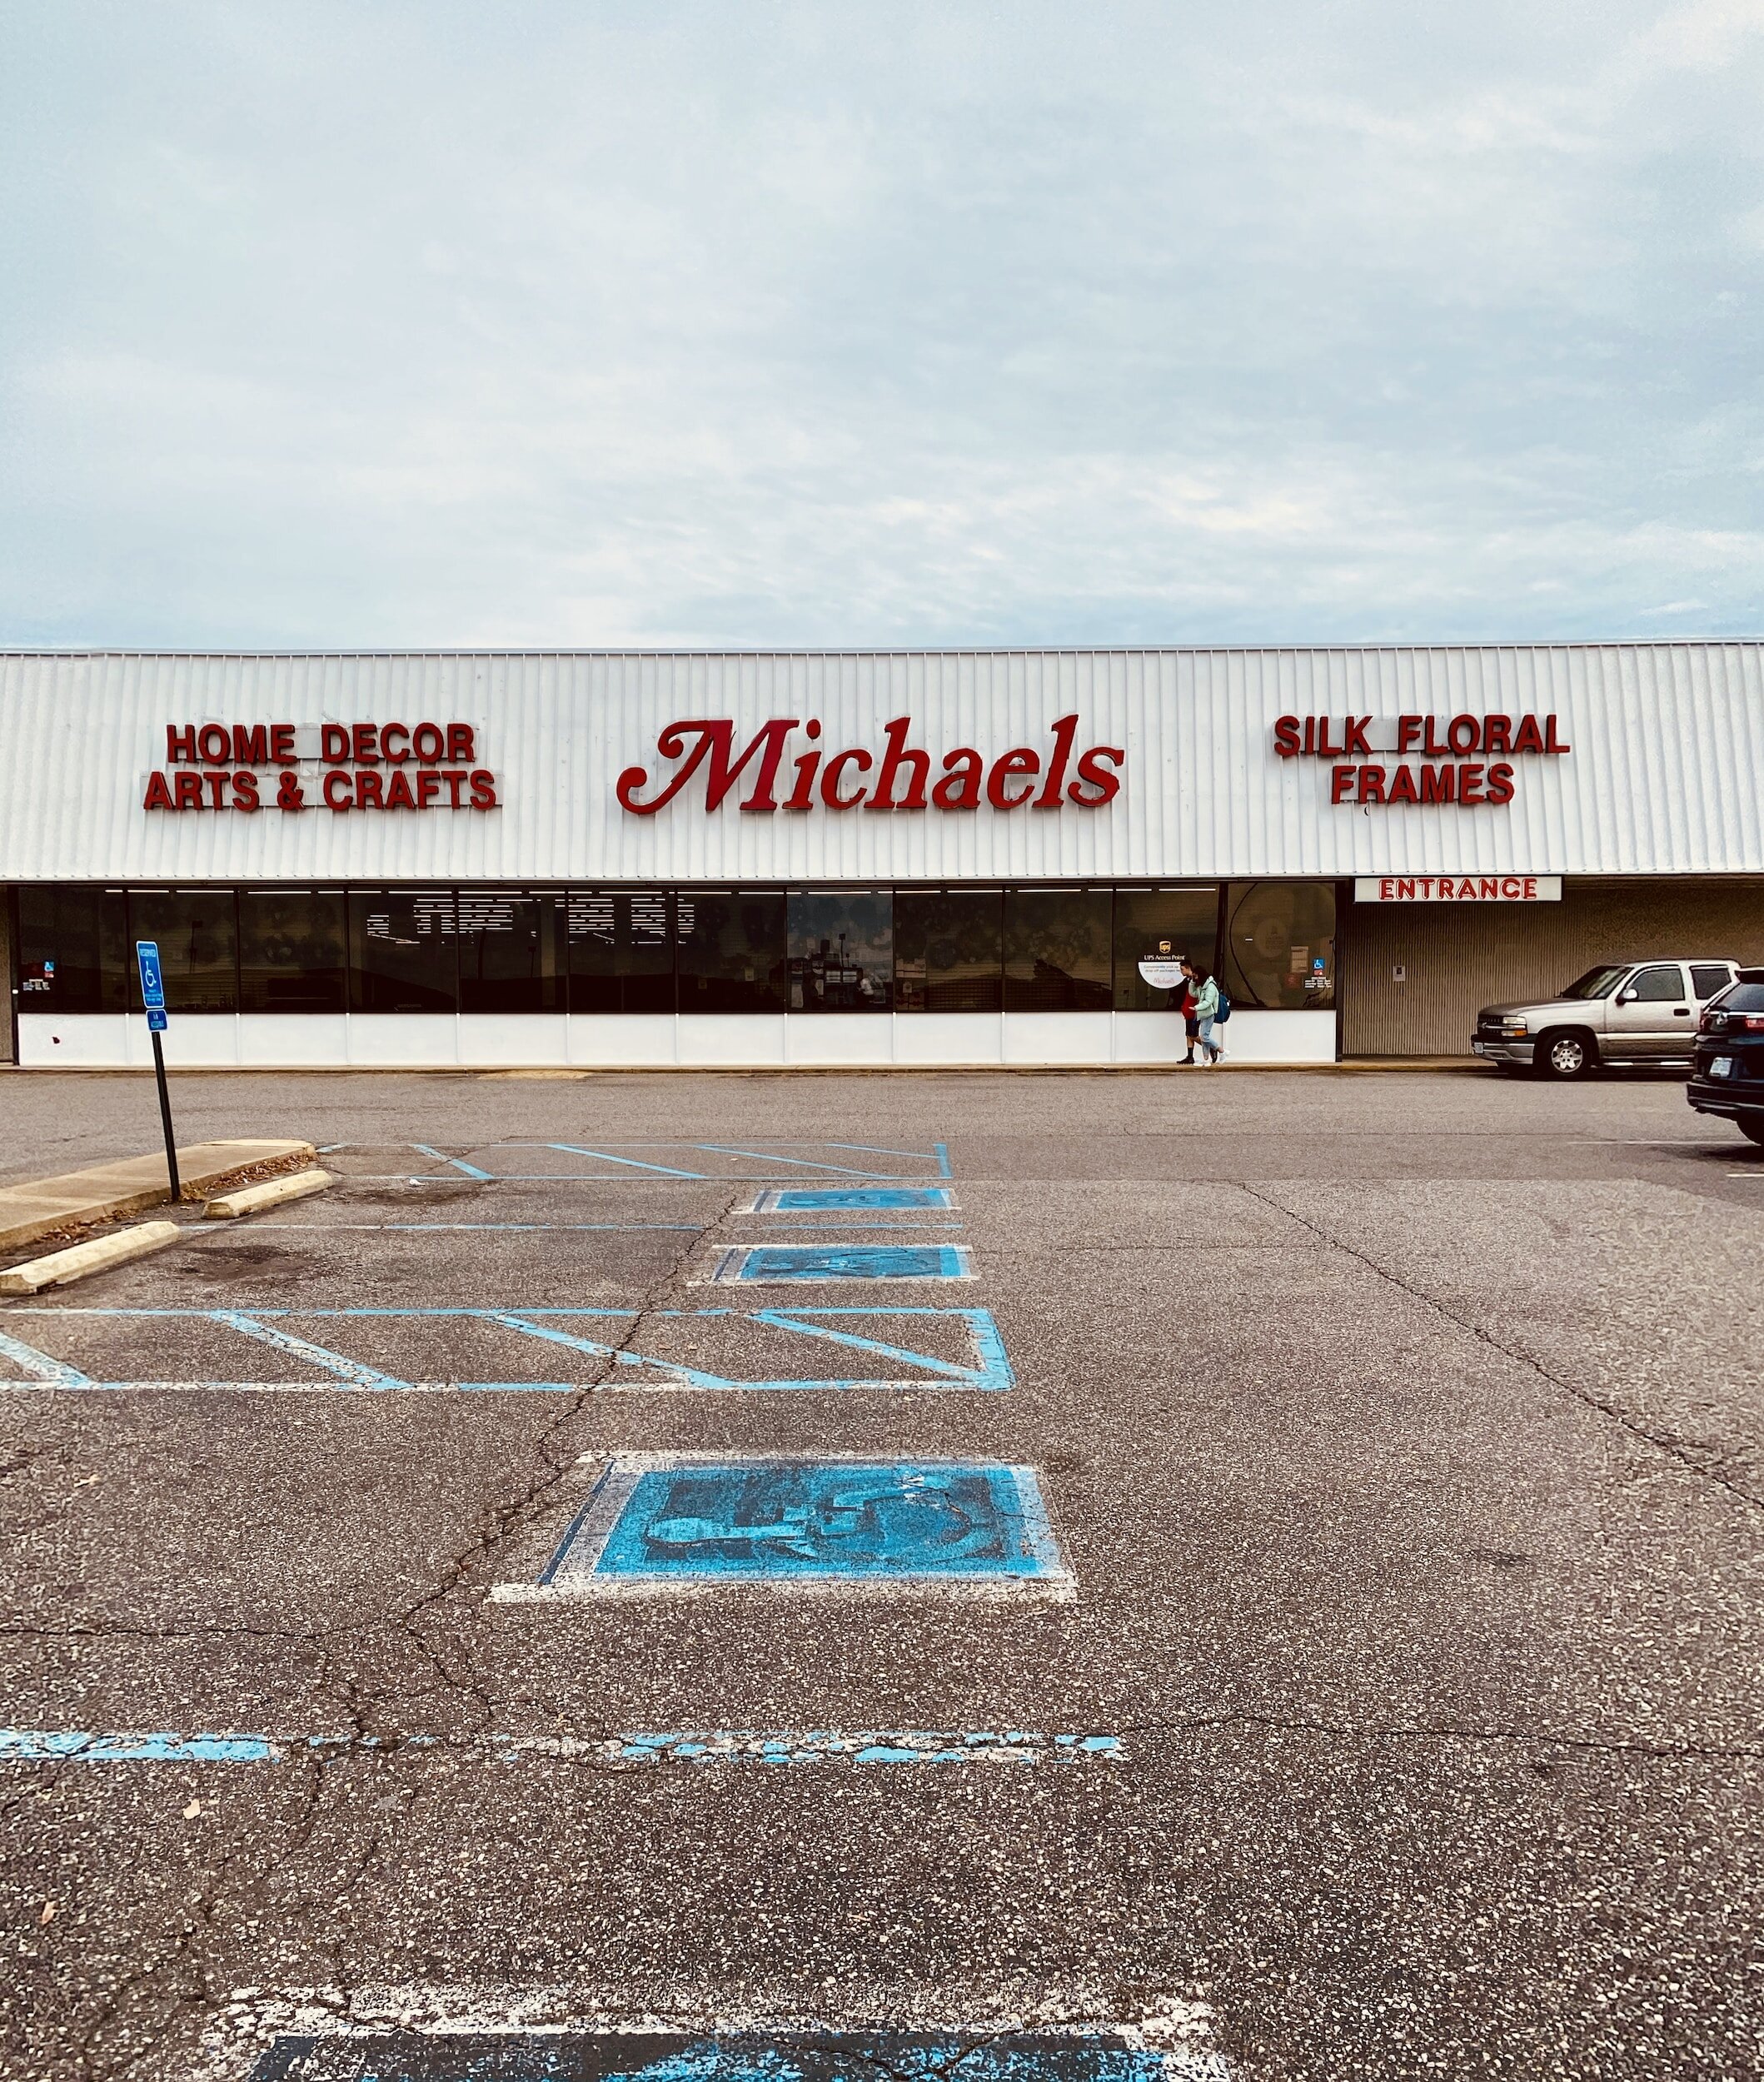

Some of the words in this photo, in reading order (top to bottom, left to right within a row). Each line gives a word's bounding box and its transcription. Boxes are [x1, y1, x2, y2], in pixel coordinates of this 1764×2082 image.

[166, 723, 298, 765] HOME
[321, 722, 476, 765] DECOR
[1273, 715, 1373, 756] SILK
[1398, 714, 1571, 756] FLORAL
[616, 714, 1124, 814] Michaels
[1331, 763, 1515, 804] FRAMES
[143, 770, 260, 811] ARTS
[277, 770, 306, 810] &
[322, 769, 496, 811] CRAFTS
[1378, 878, 1537, 900] ENTRANCE
